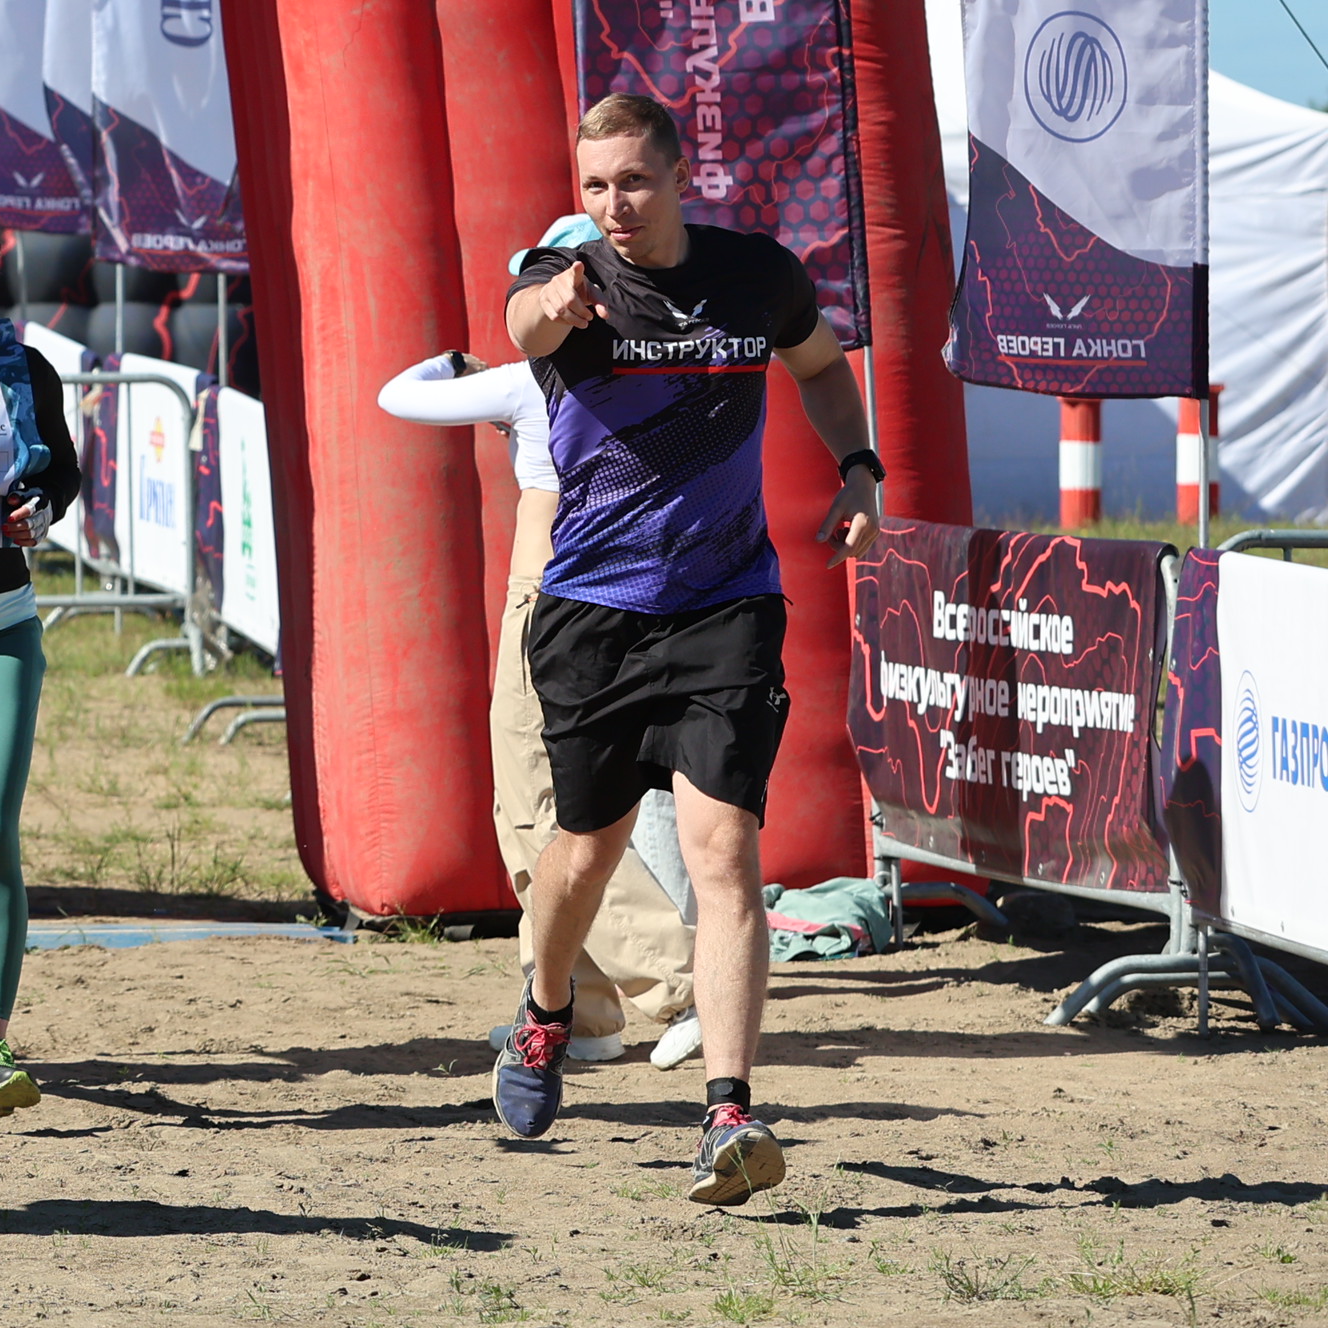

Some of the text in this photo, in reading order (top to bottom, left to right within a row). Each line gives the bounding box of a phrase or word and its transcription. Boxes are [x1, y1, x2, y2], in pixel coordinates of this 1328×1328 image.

[612, 336, 767, 361] ИНСТРУКТОР
[932, 589, 1074, 656] Всероссийское
[1017, 681, 1136, 739] мероприятие
